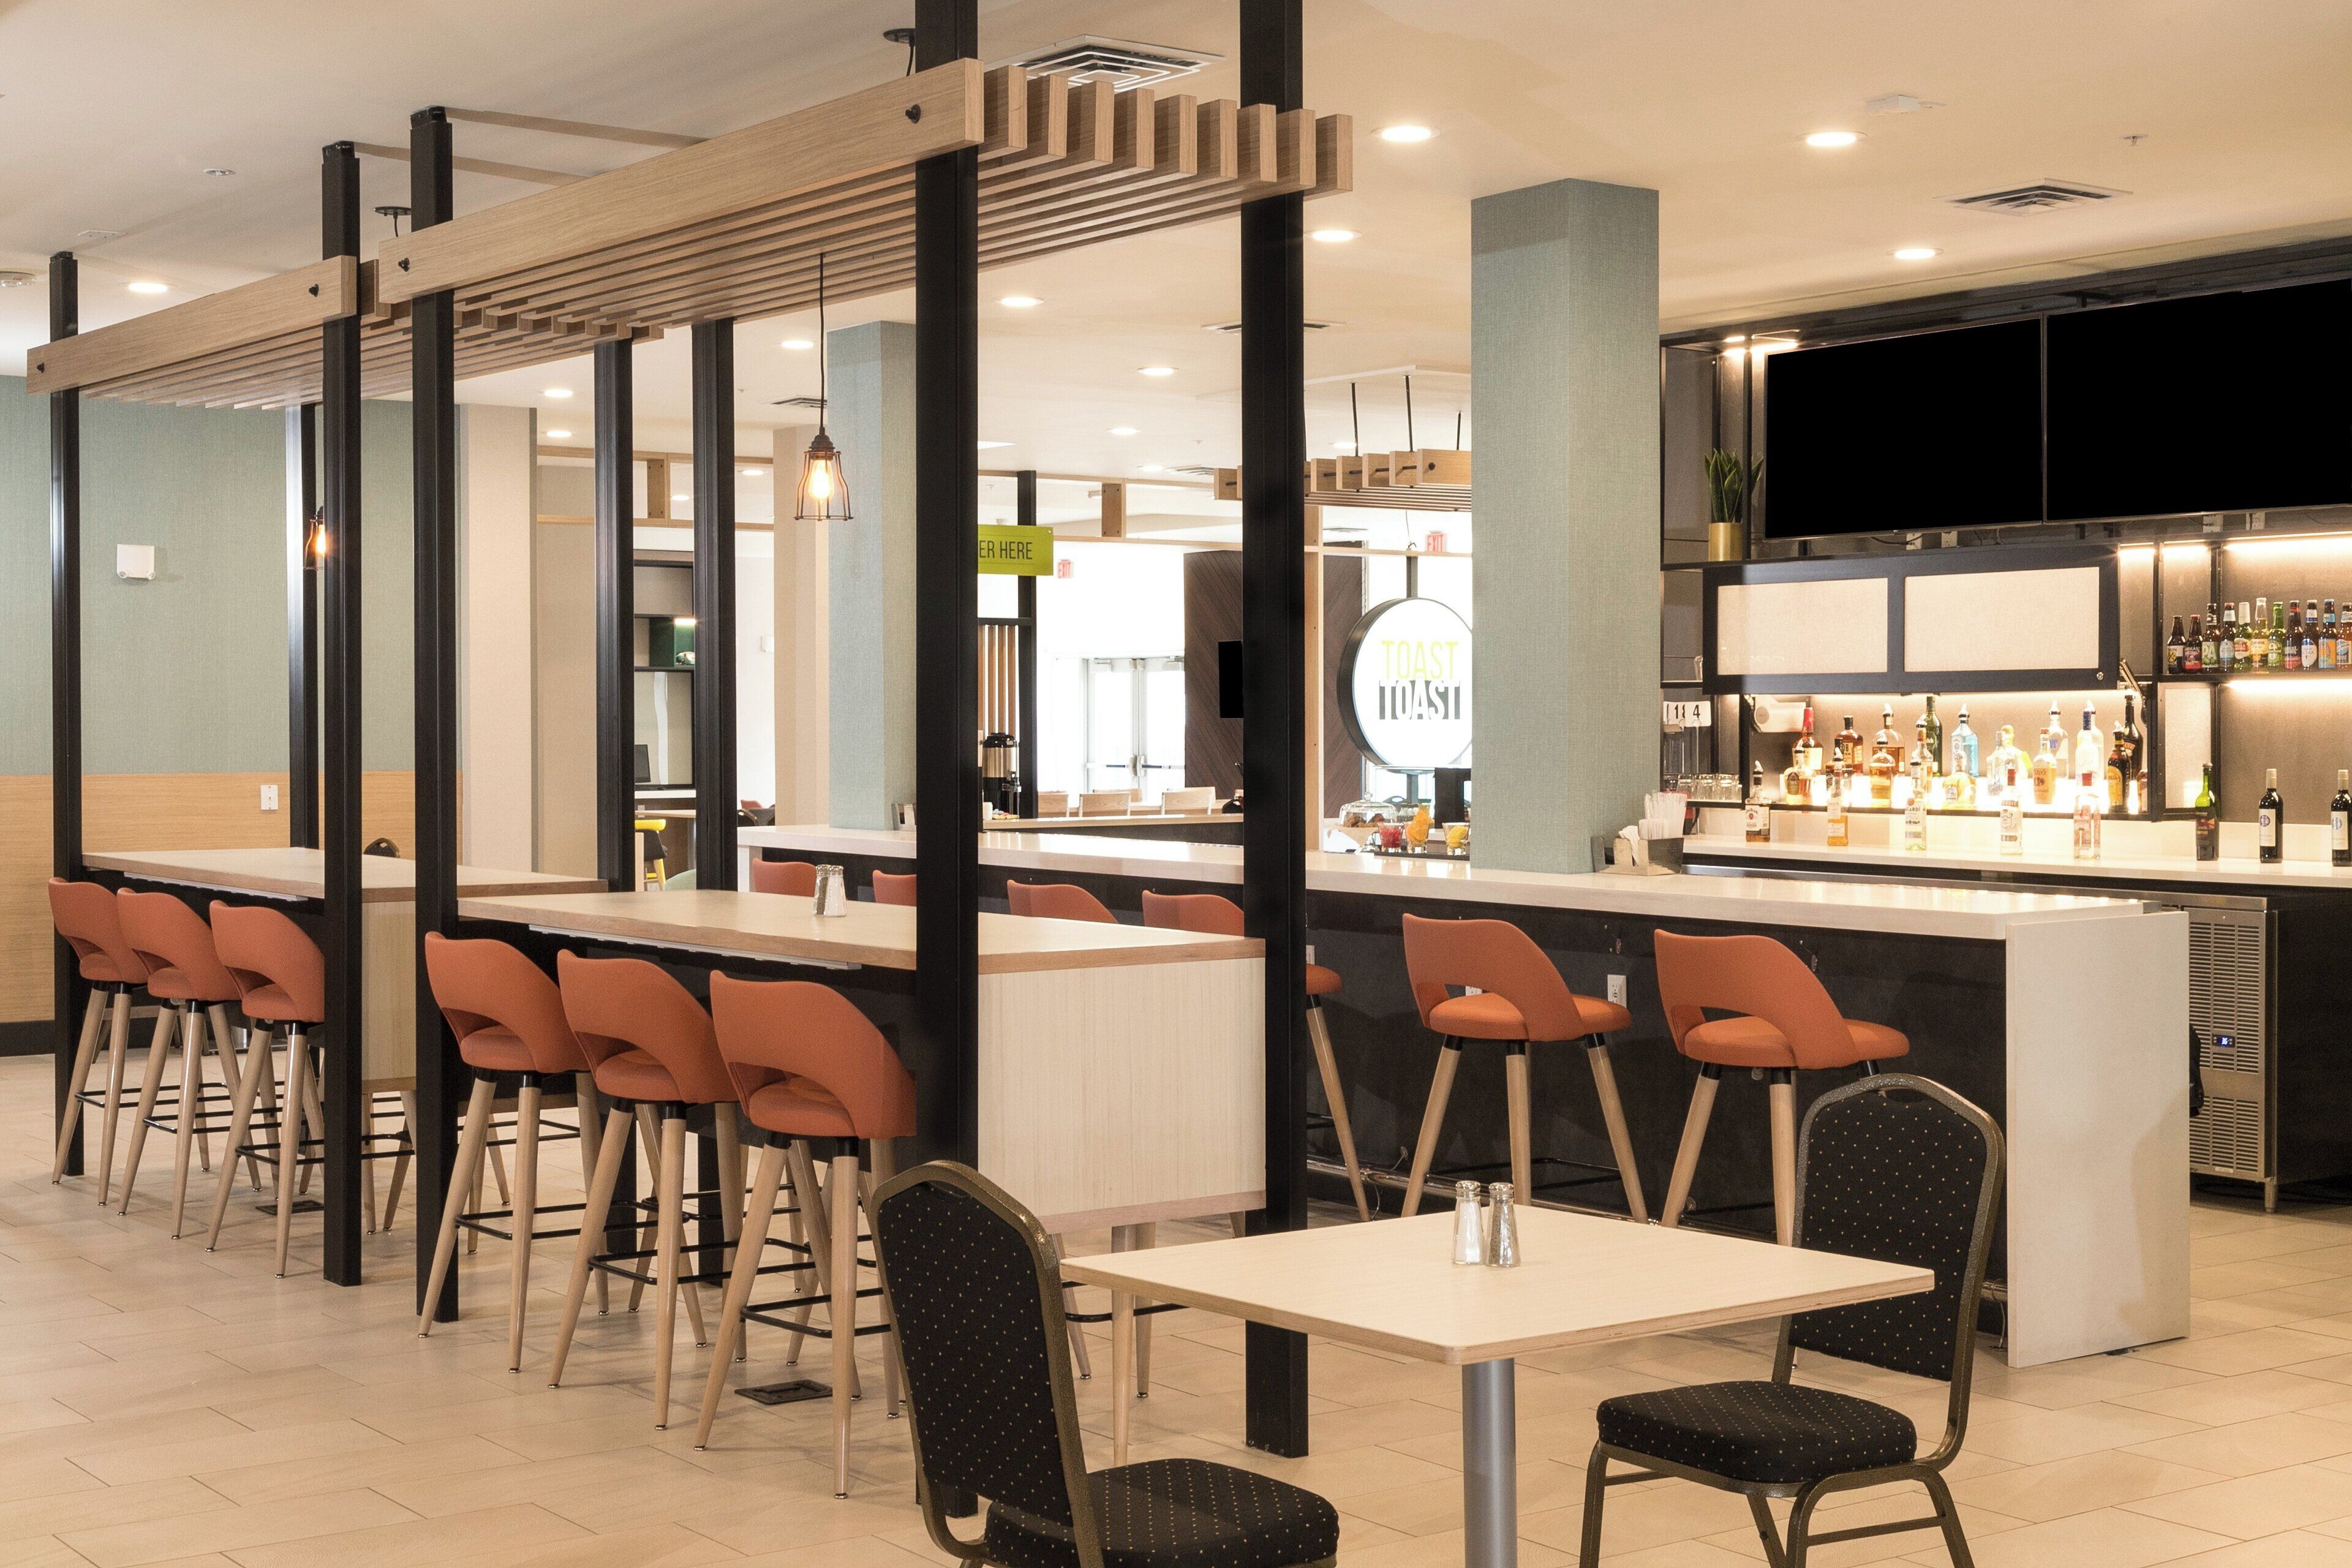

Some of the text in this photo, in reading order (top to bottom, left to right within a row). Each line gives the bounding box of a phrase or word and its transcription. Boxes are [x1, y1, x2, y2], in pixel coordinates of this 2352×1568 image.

[1000, 541, 1033, 560] HERE
[1427, 534, 1444, 552] EXIT
[1058, 562, 1071, 578] EXIT
[1381, 640, 1458, 680] TOAST
[1379, 680, 1461, 720] TOAST
[1693, 704, 1701, 718] 4
